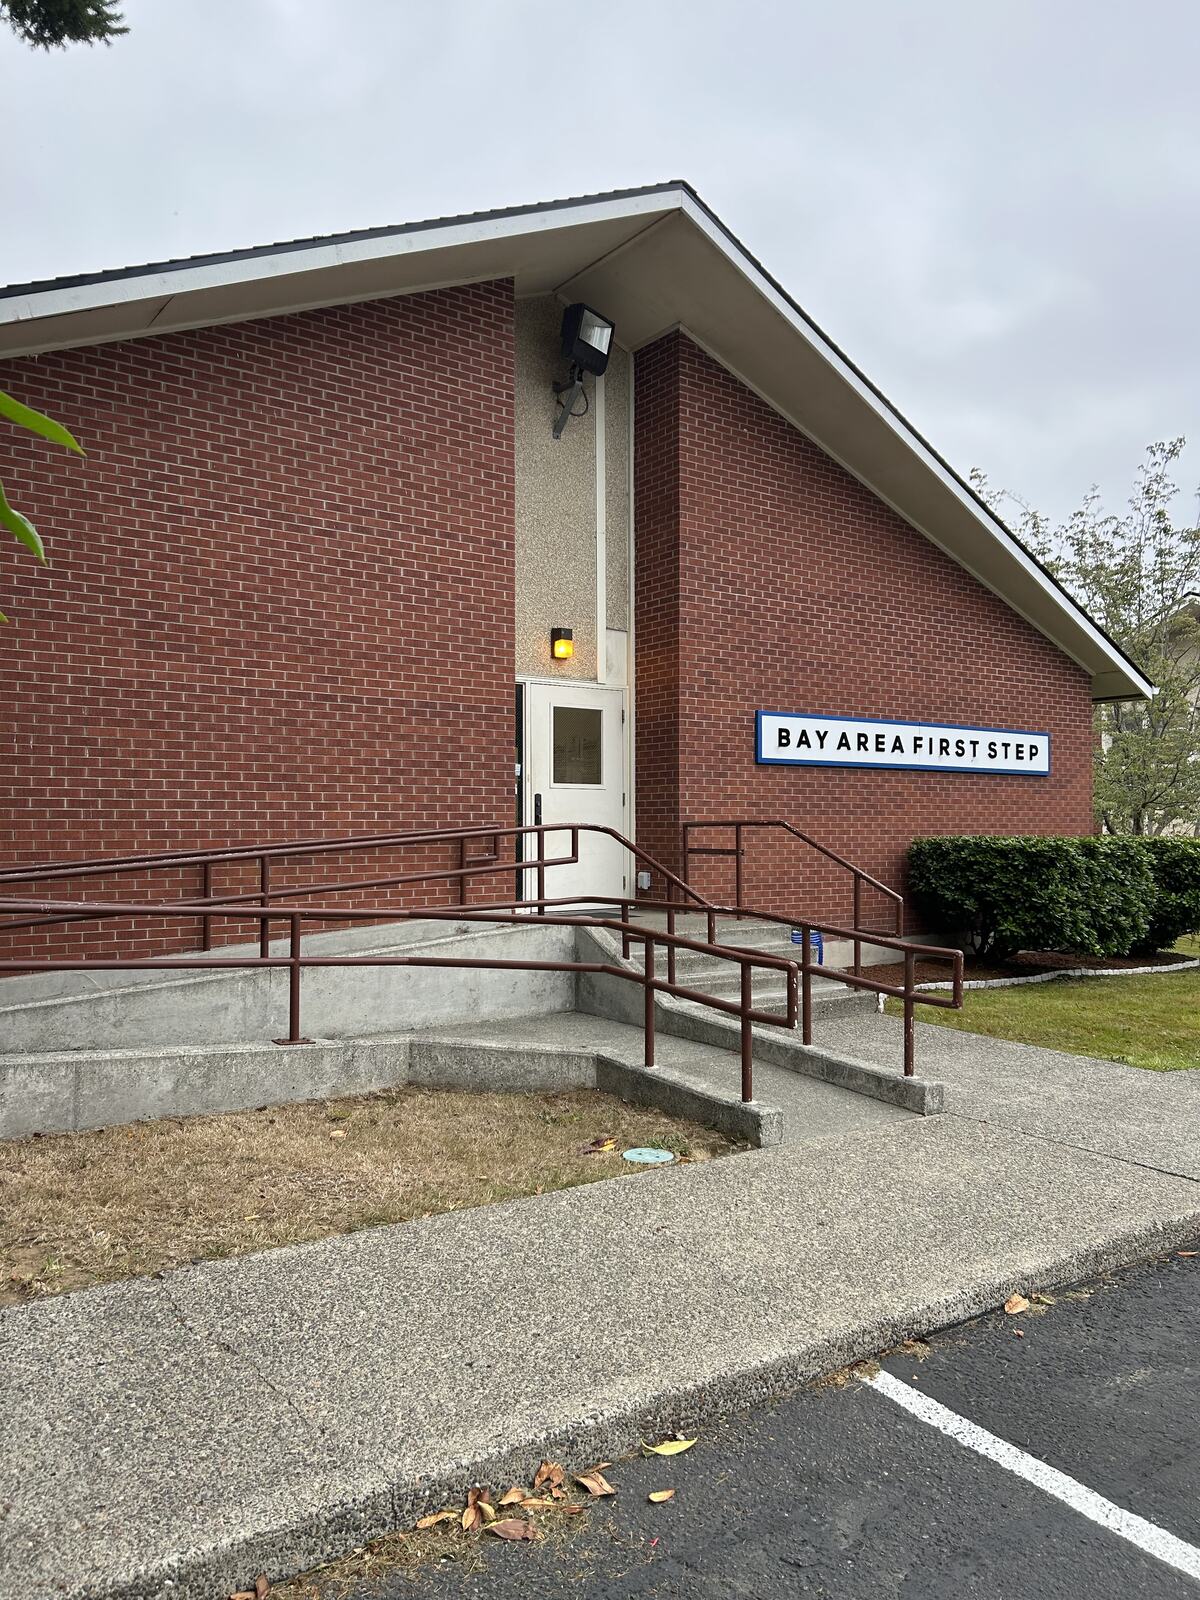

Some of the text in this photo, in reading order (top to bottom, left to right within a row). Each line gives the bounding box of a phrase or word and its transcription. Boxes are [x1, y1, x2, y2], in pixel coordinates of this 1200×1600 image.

[778, 728, 1039, 761] BAY AREA FIRST STEP
